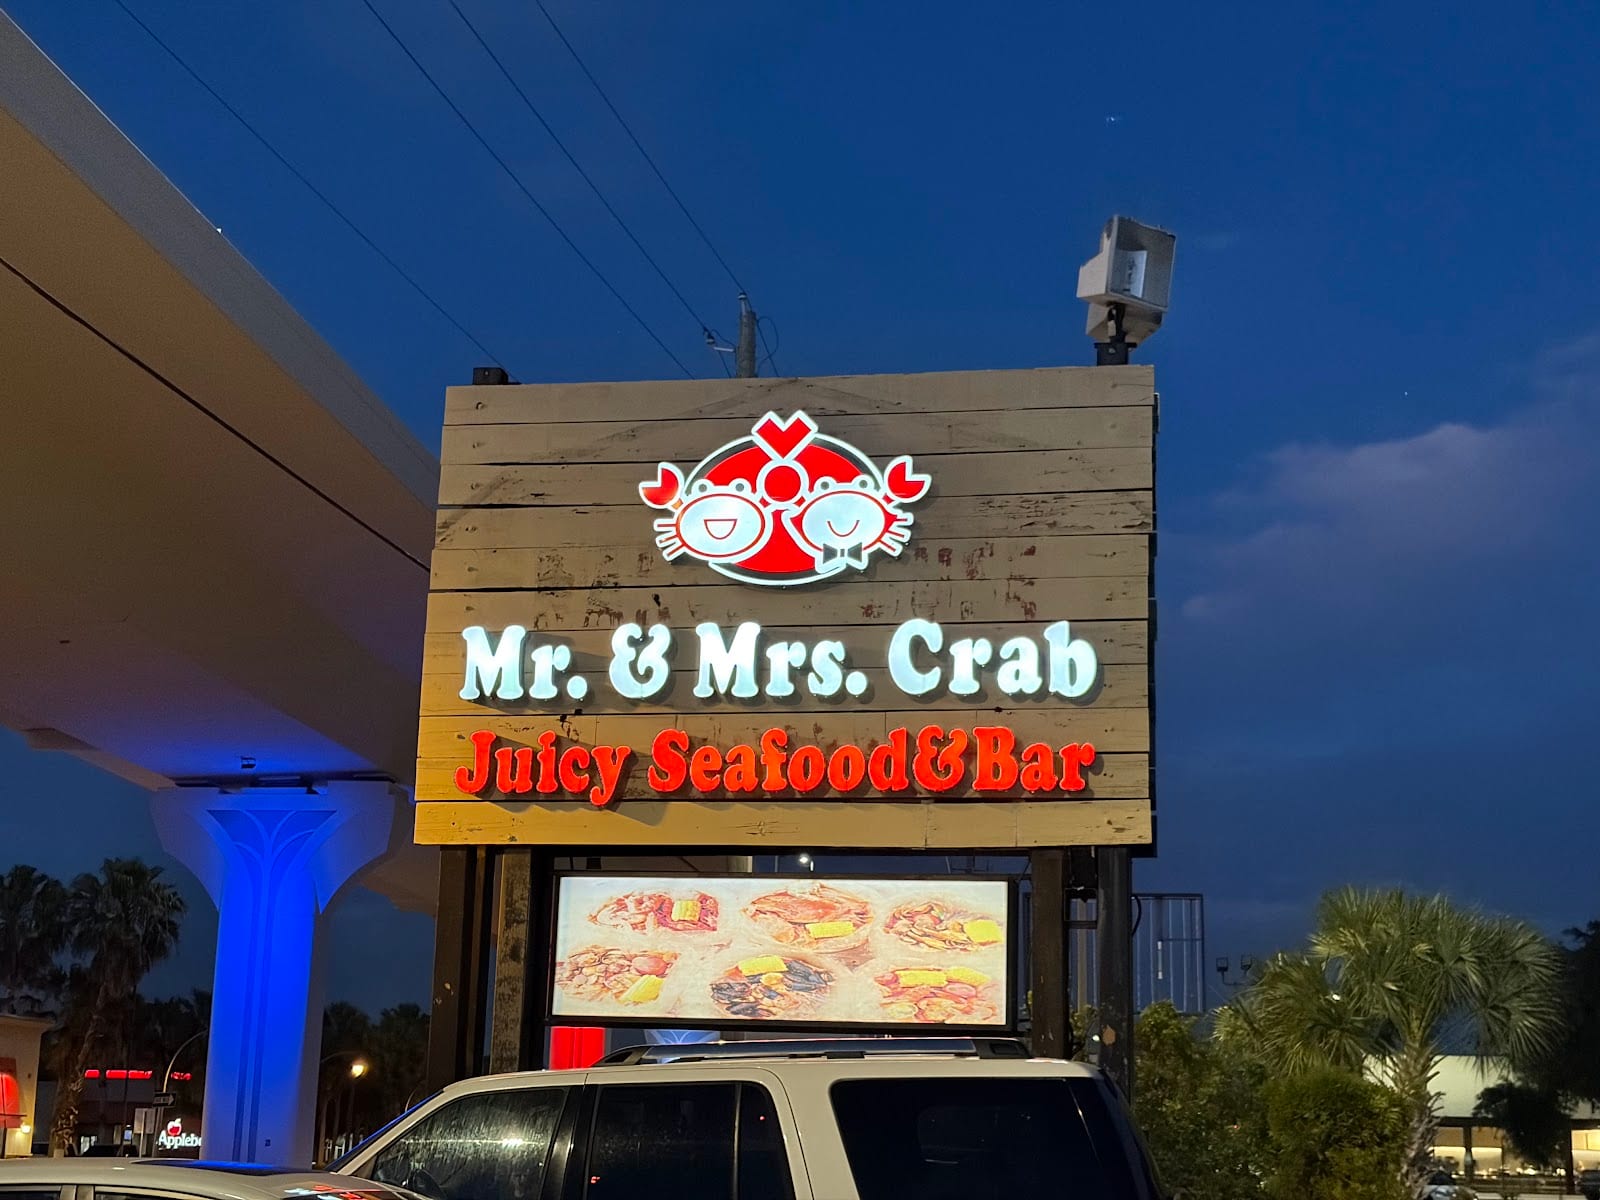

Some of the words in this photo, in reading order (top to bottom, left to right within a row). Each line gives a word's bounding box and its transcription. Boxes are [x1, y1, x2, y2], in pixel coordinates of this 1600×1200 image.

[459, 624, 588, 700] Mr.
[609, 623, 671, 698] &
[693, 622, 868, 698] Mrs.
[888, 619, 1097, 697] Crab
[454, 730, 631, 806] Juicy
